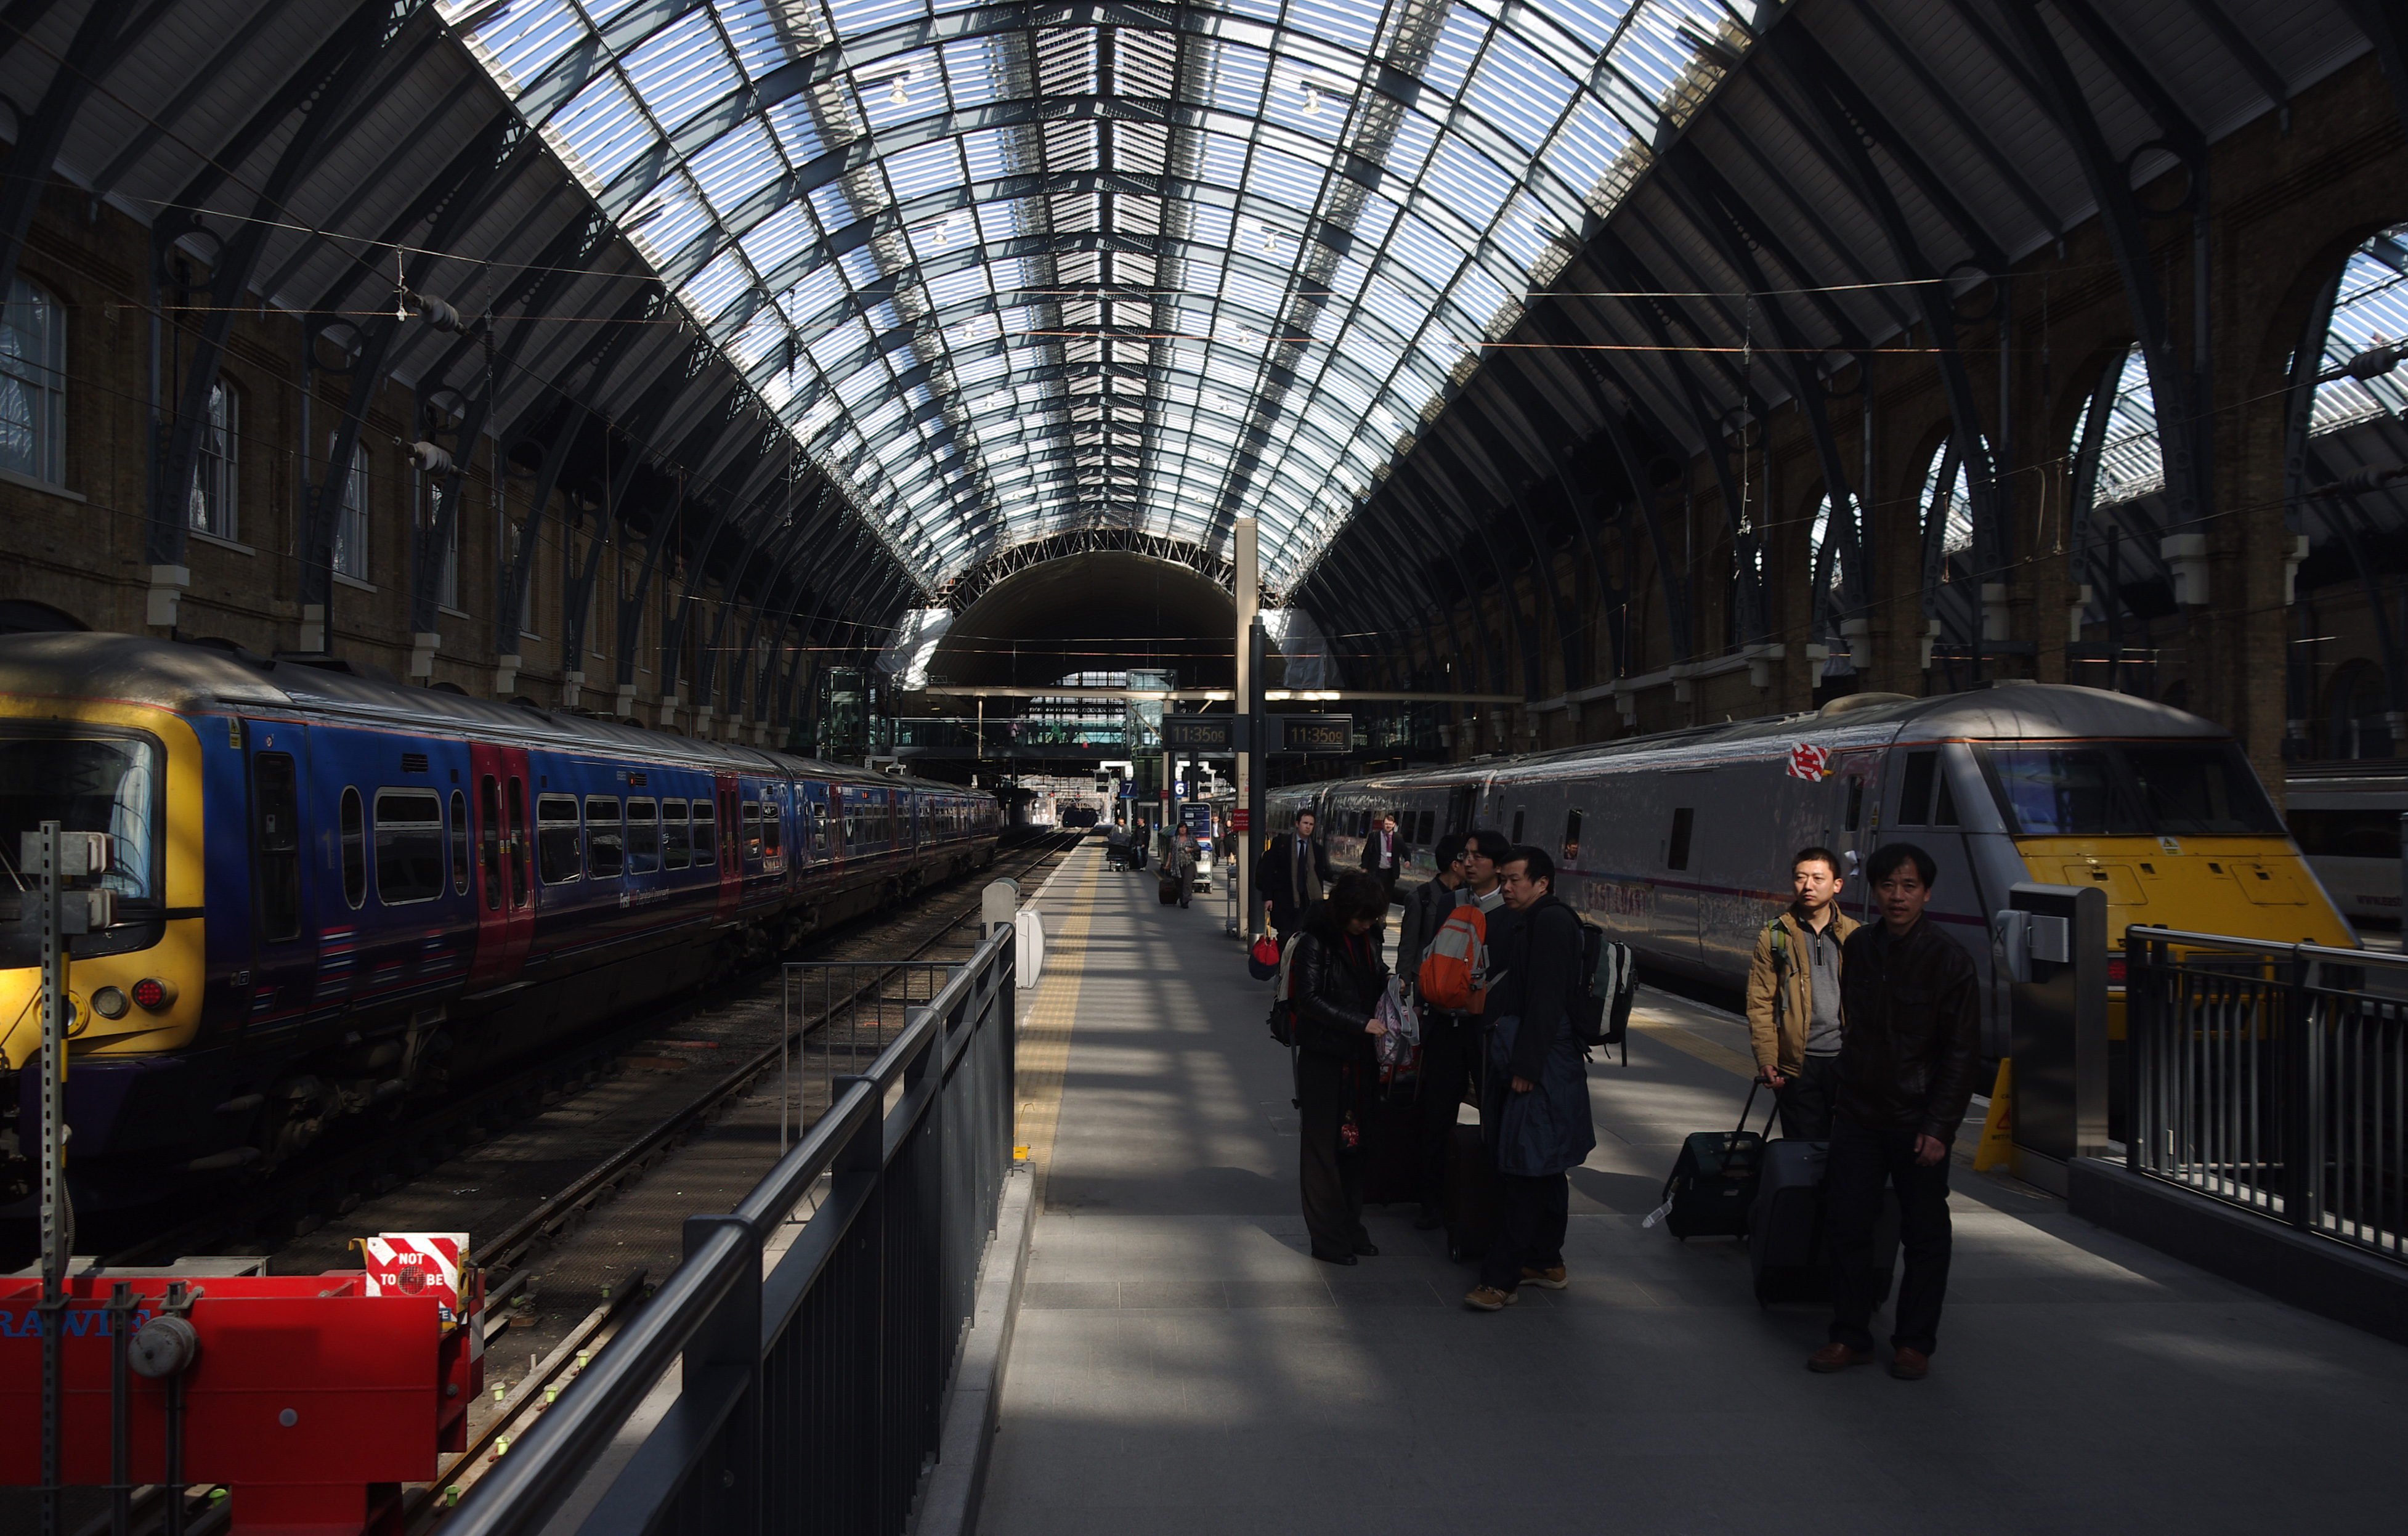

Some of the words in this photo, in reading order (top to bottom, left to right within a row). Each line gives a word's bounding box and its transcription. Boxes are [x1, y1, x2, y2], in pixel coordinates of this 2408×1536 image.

[1125, 783, 1133, 794] 7
[1175, 782, 1185, 795] 6
[497, 781, 503, 810] 1
[399, 1253, 424, 1265] NOT
[380, 1274, 396, 1286] TO
[426, 1274, 444, 1286] BE
